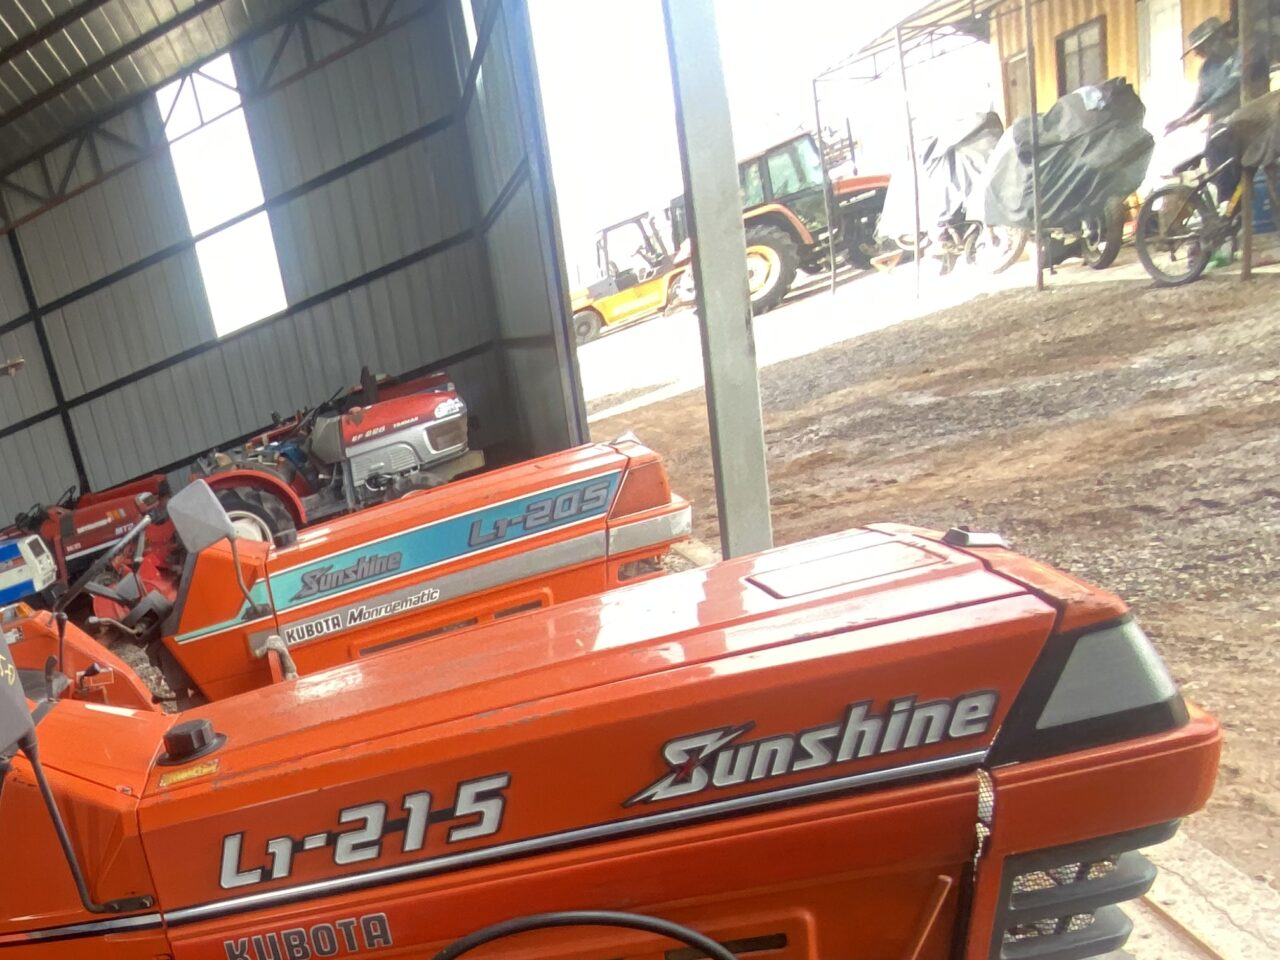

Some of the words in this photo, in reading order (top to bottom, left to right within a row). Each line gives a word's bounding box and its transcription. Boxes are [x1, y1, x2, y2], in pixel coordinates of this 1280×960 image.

[290, 552, 403, 602] Sunshine
[286, 614, 342, 647] KUBOTA
[347, 588, 440, 627] Monroematic
[624, 690, 999, 806] Sunshine
